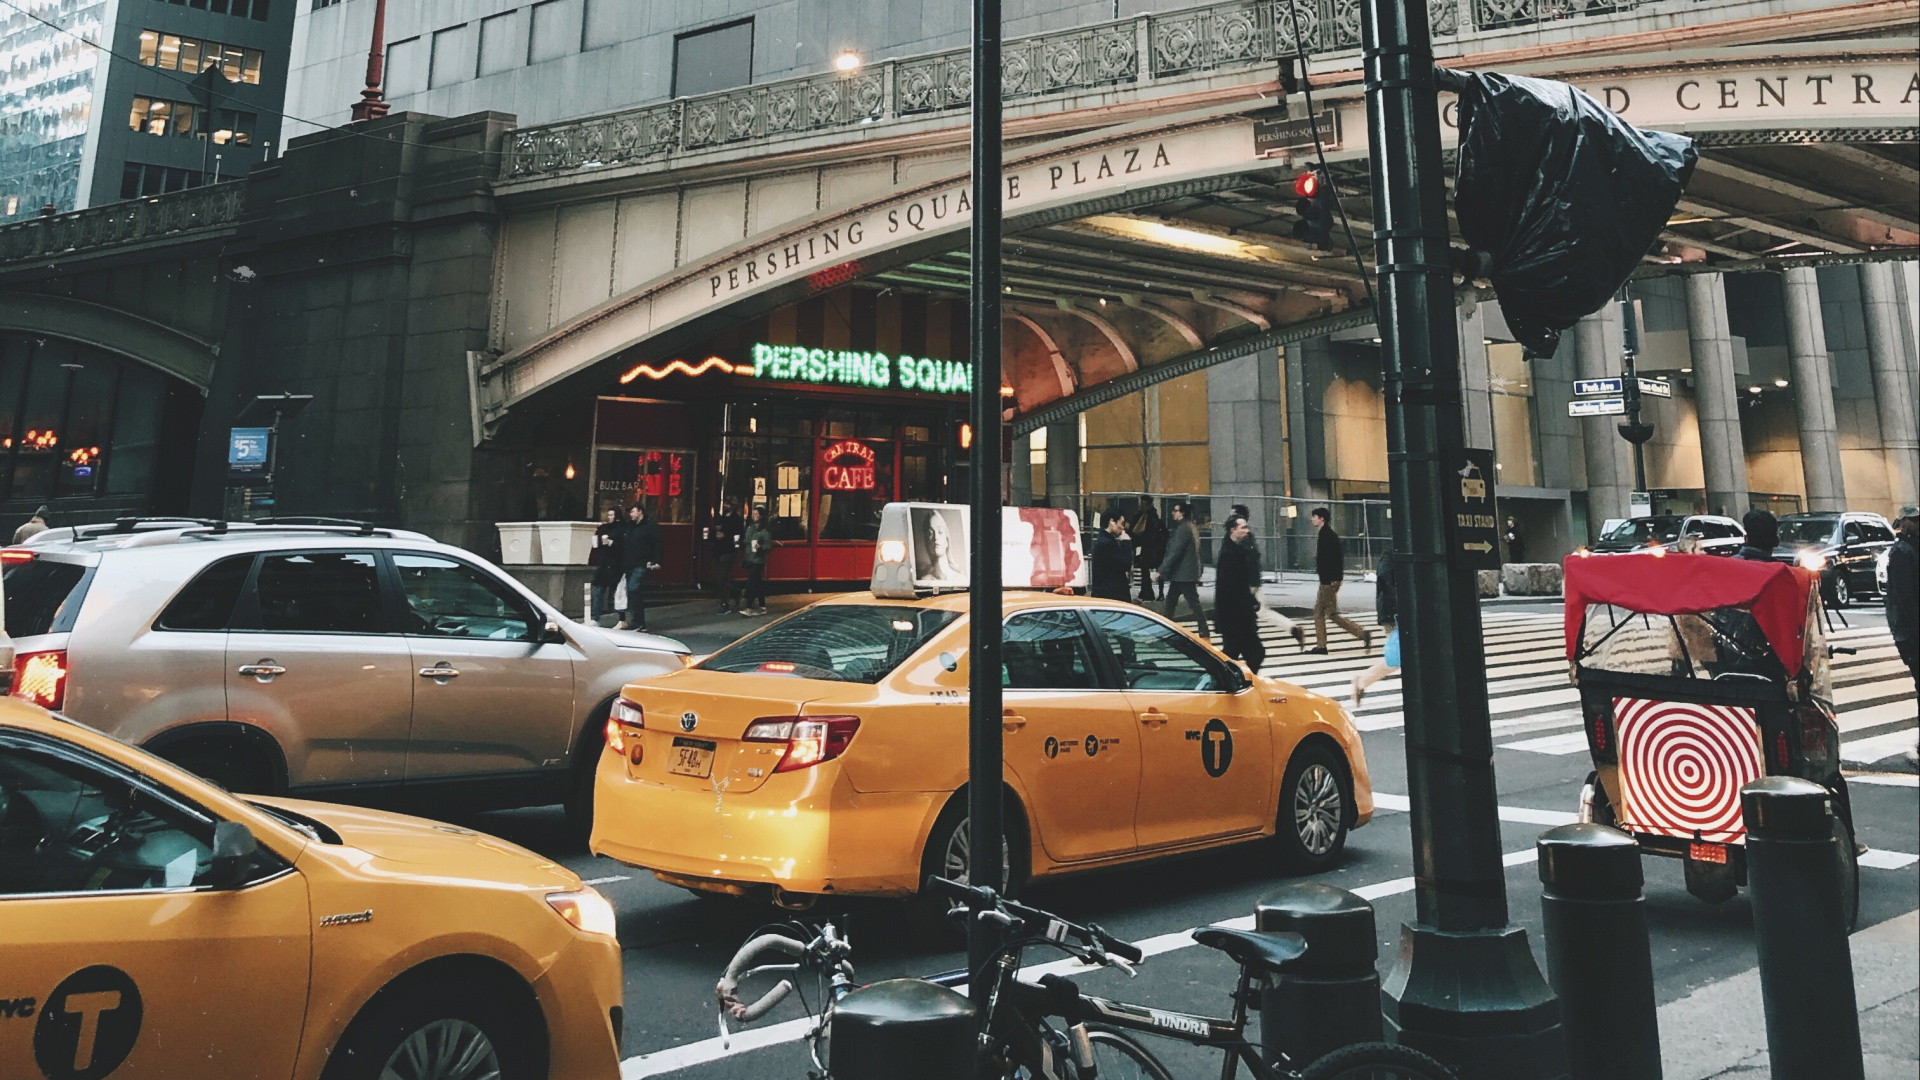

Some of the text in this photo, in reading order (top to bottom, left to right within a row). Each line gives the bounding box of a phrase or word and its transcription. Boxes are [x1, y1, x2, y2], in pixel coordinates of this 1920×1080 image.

[1257, 129, 1298, 143] PERSHING
[710, 142, 1171, 298] PERSHING SQUAE PLAZA
[752, 342, 891, 388] PERSHING
[234, 439, 250, 459] $5
[599, 480, 620, 491] BUZZ
[756, 480, 764, 490] A
[823, 466, 875, 489] CAFE
[1457, 513, 1495, 528] TAXI STAND
[1185, 730, 1226, 770] NYC T
[63, 989, 122, 1071] T
[1149, 1010, 1210, 1036] TUNDRA
